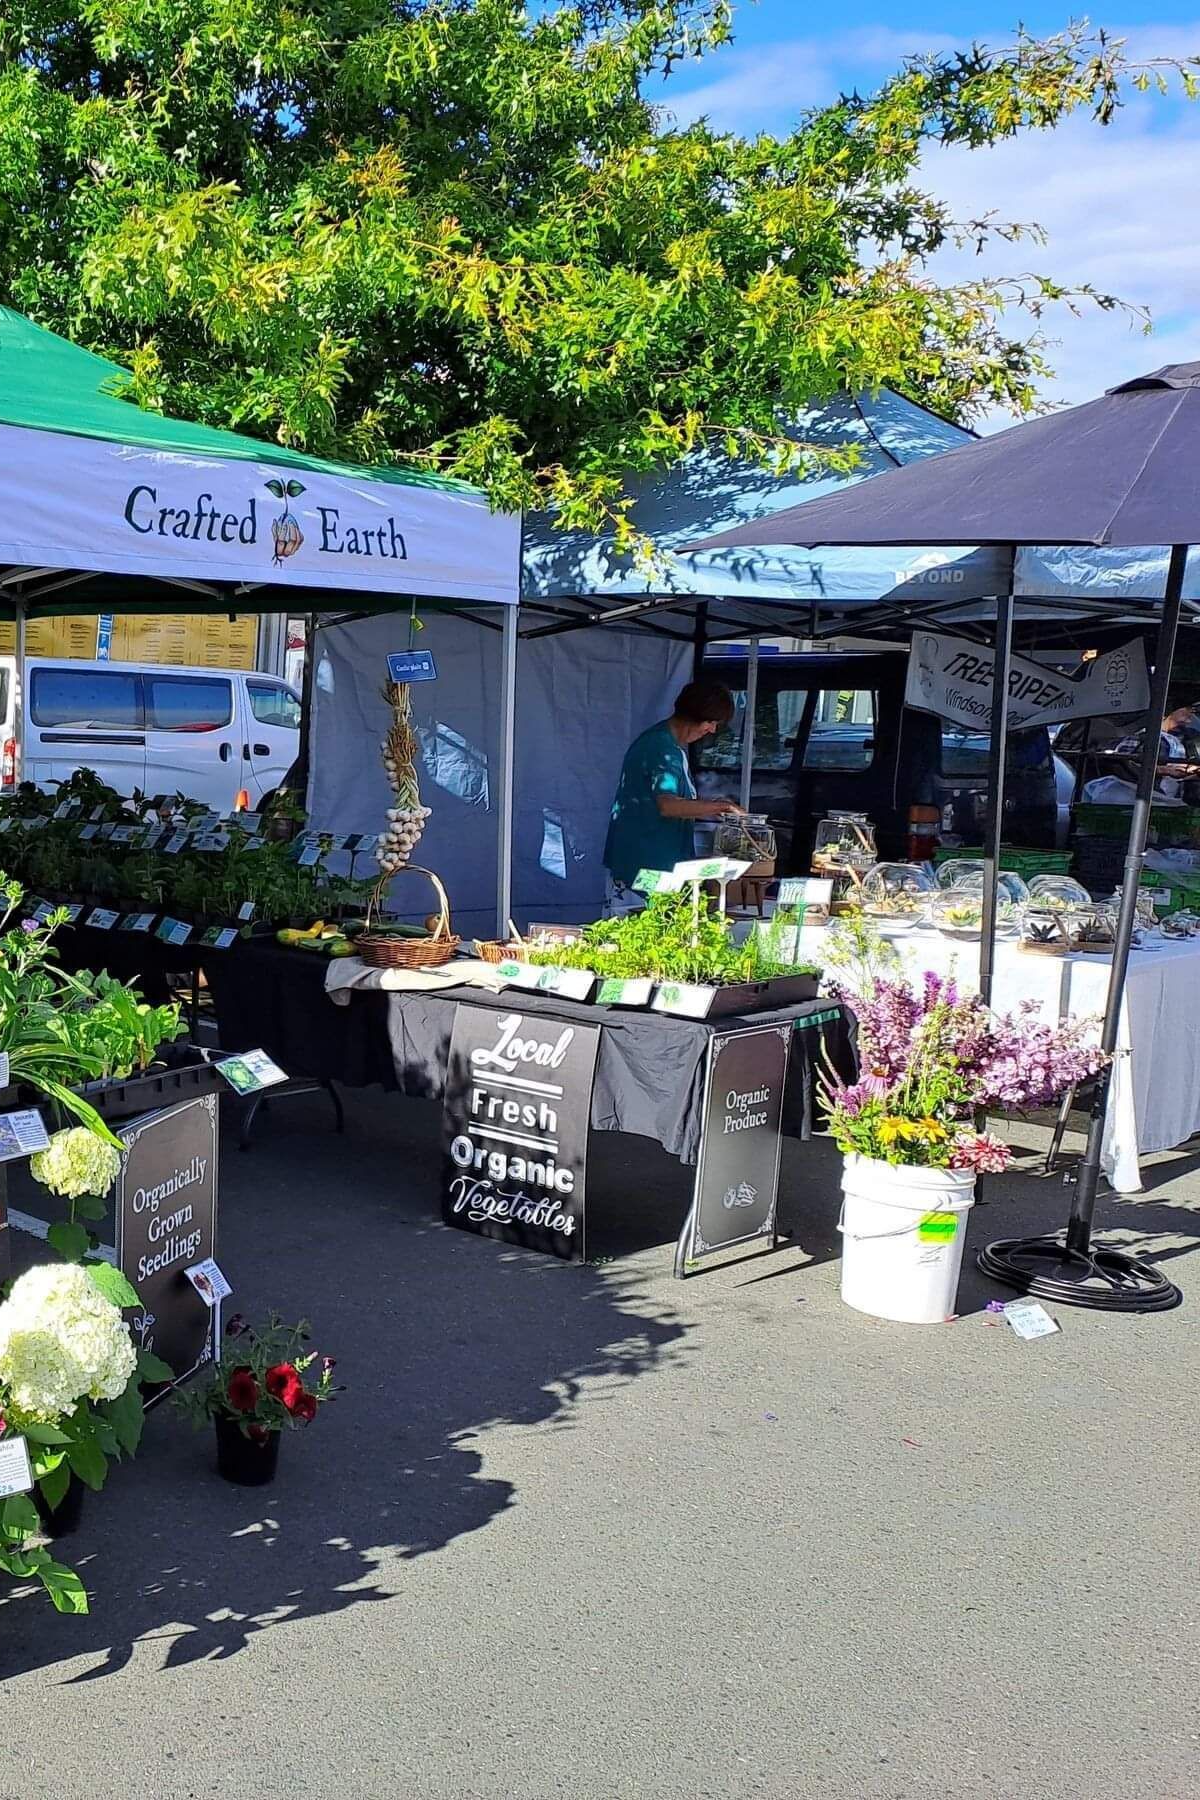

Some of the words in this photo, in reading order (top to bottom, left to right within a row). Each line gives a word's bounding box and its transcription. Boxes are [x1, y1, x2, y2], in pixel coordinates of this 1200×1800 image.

[124, 485, 257, 544] Crafted
[316, 506, 408, 560] Earth
[895, 569, 964, 584] BEYOND
[943, 652, 996, 688] TREE
[471, 1014, 575, 1072] Local
[471, 1088, 558, 1133] Fresh
[723, 1110, 768, 1134] Produce
[725, 1084, 771, 1113] Organic
[133, 1155, 208, 1214] Organically
[450, 1135, 575, 1194] Organic
[148, 1203, 193, 1243] Grown
[449, 1175, 577, 1237] Vegetables
[137, 1228, 202, 1283] Seedlings
